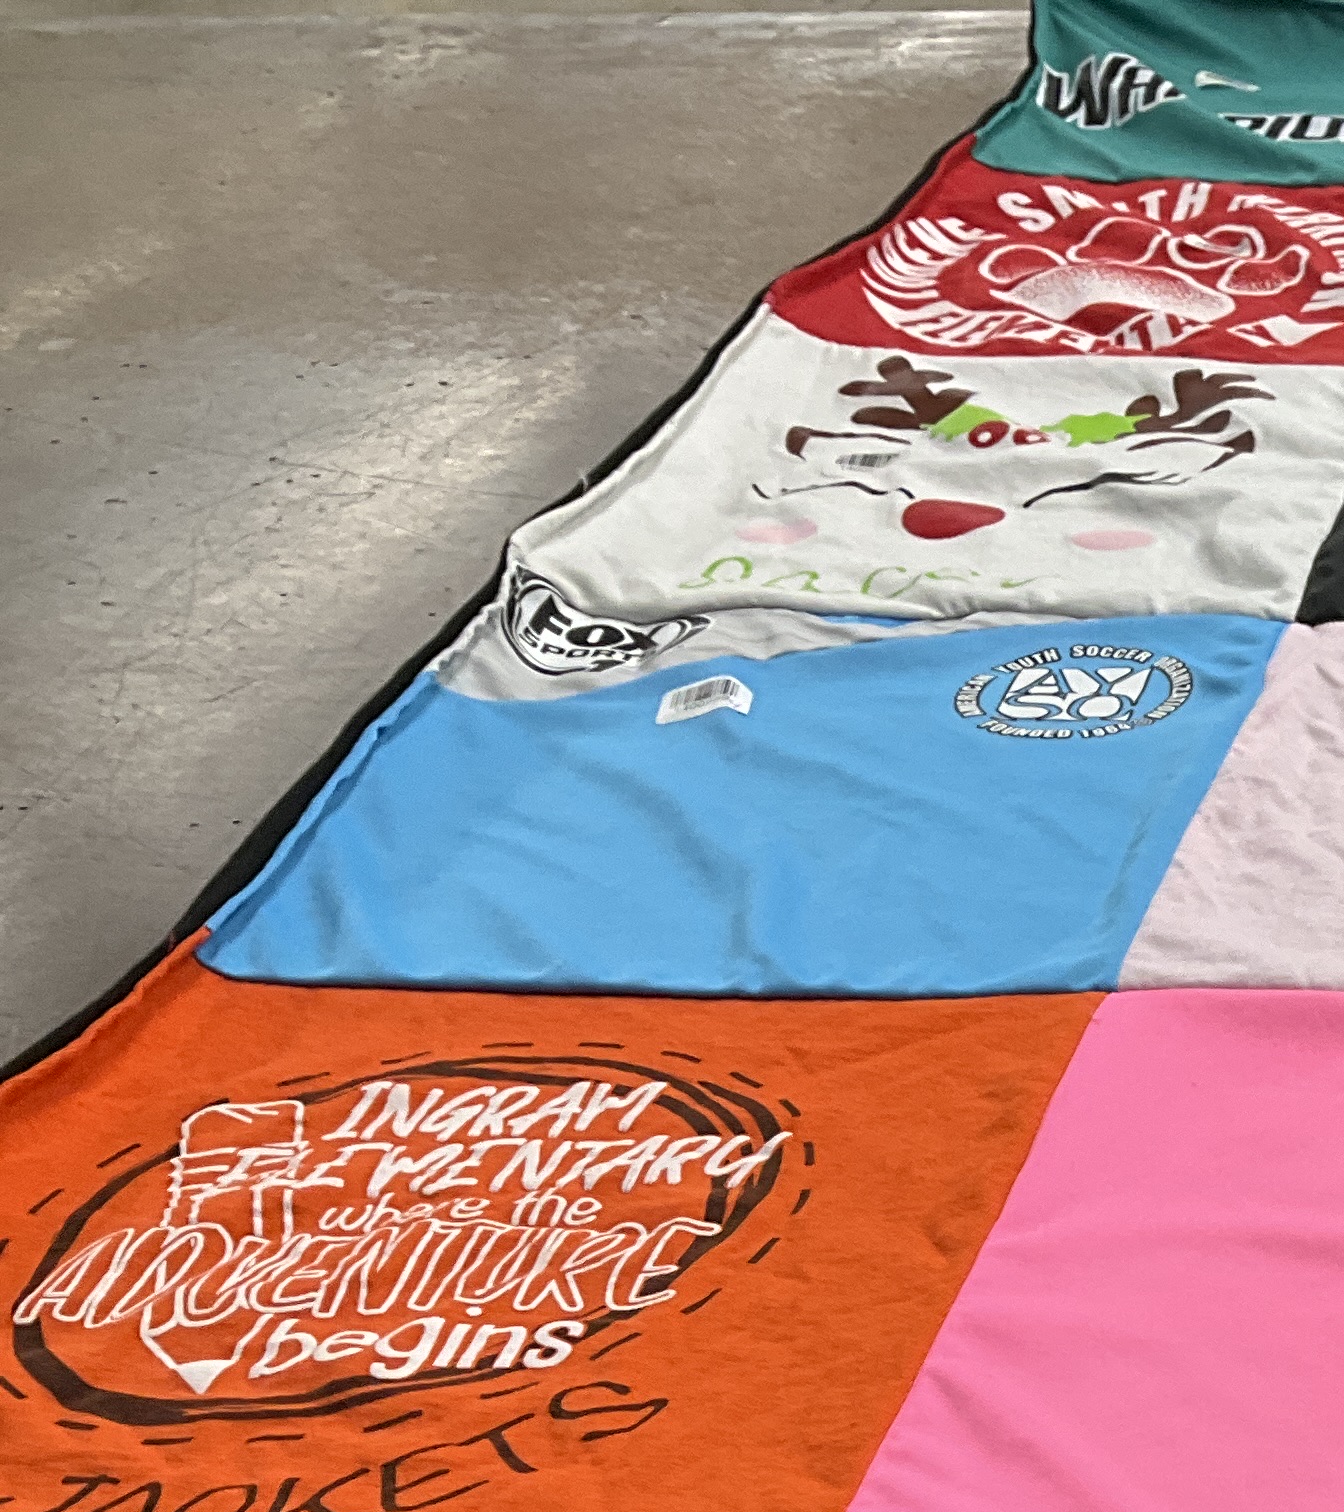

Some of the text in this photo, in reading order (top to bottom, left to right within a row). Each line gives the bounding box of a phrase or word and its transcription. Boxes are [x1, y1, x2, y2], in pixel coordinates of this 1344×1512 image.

[997, 182, 1213, 233] SMTH
[528, 594, 660, 651] FOX
[991, 647, 1061, 674] YOUTH
[1070, 645, 1154, 664] SOCCER
[510, 1188, 603, 1226] the
[247, 1302, 588, 1380] begins
